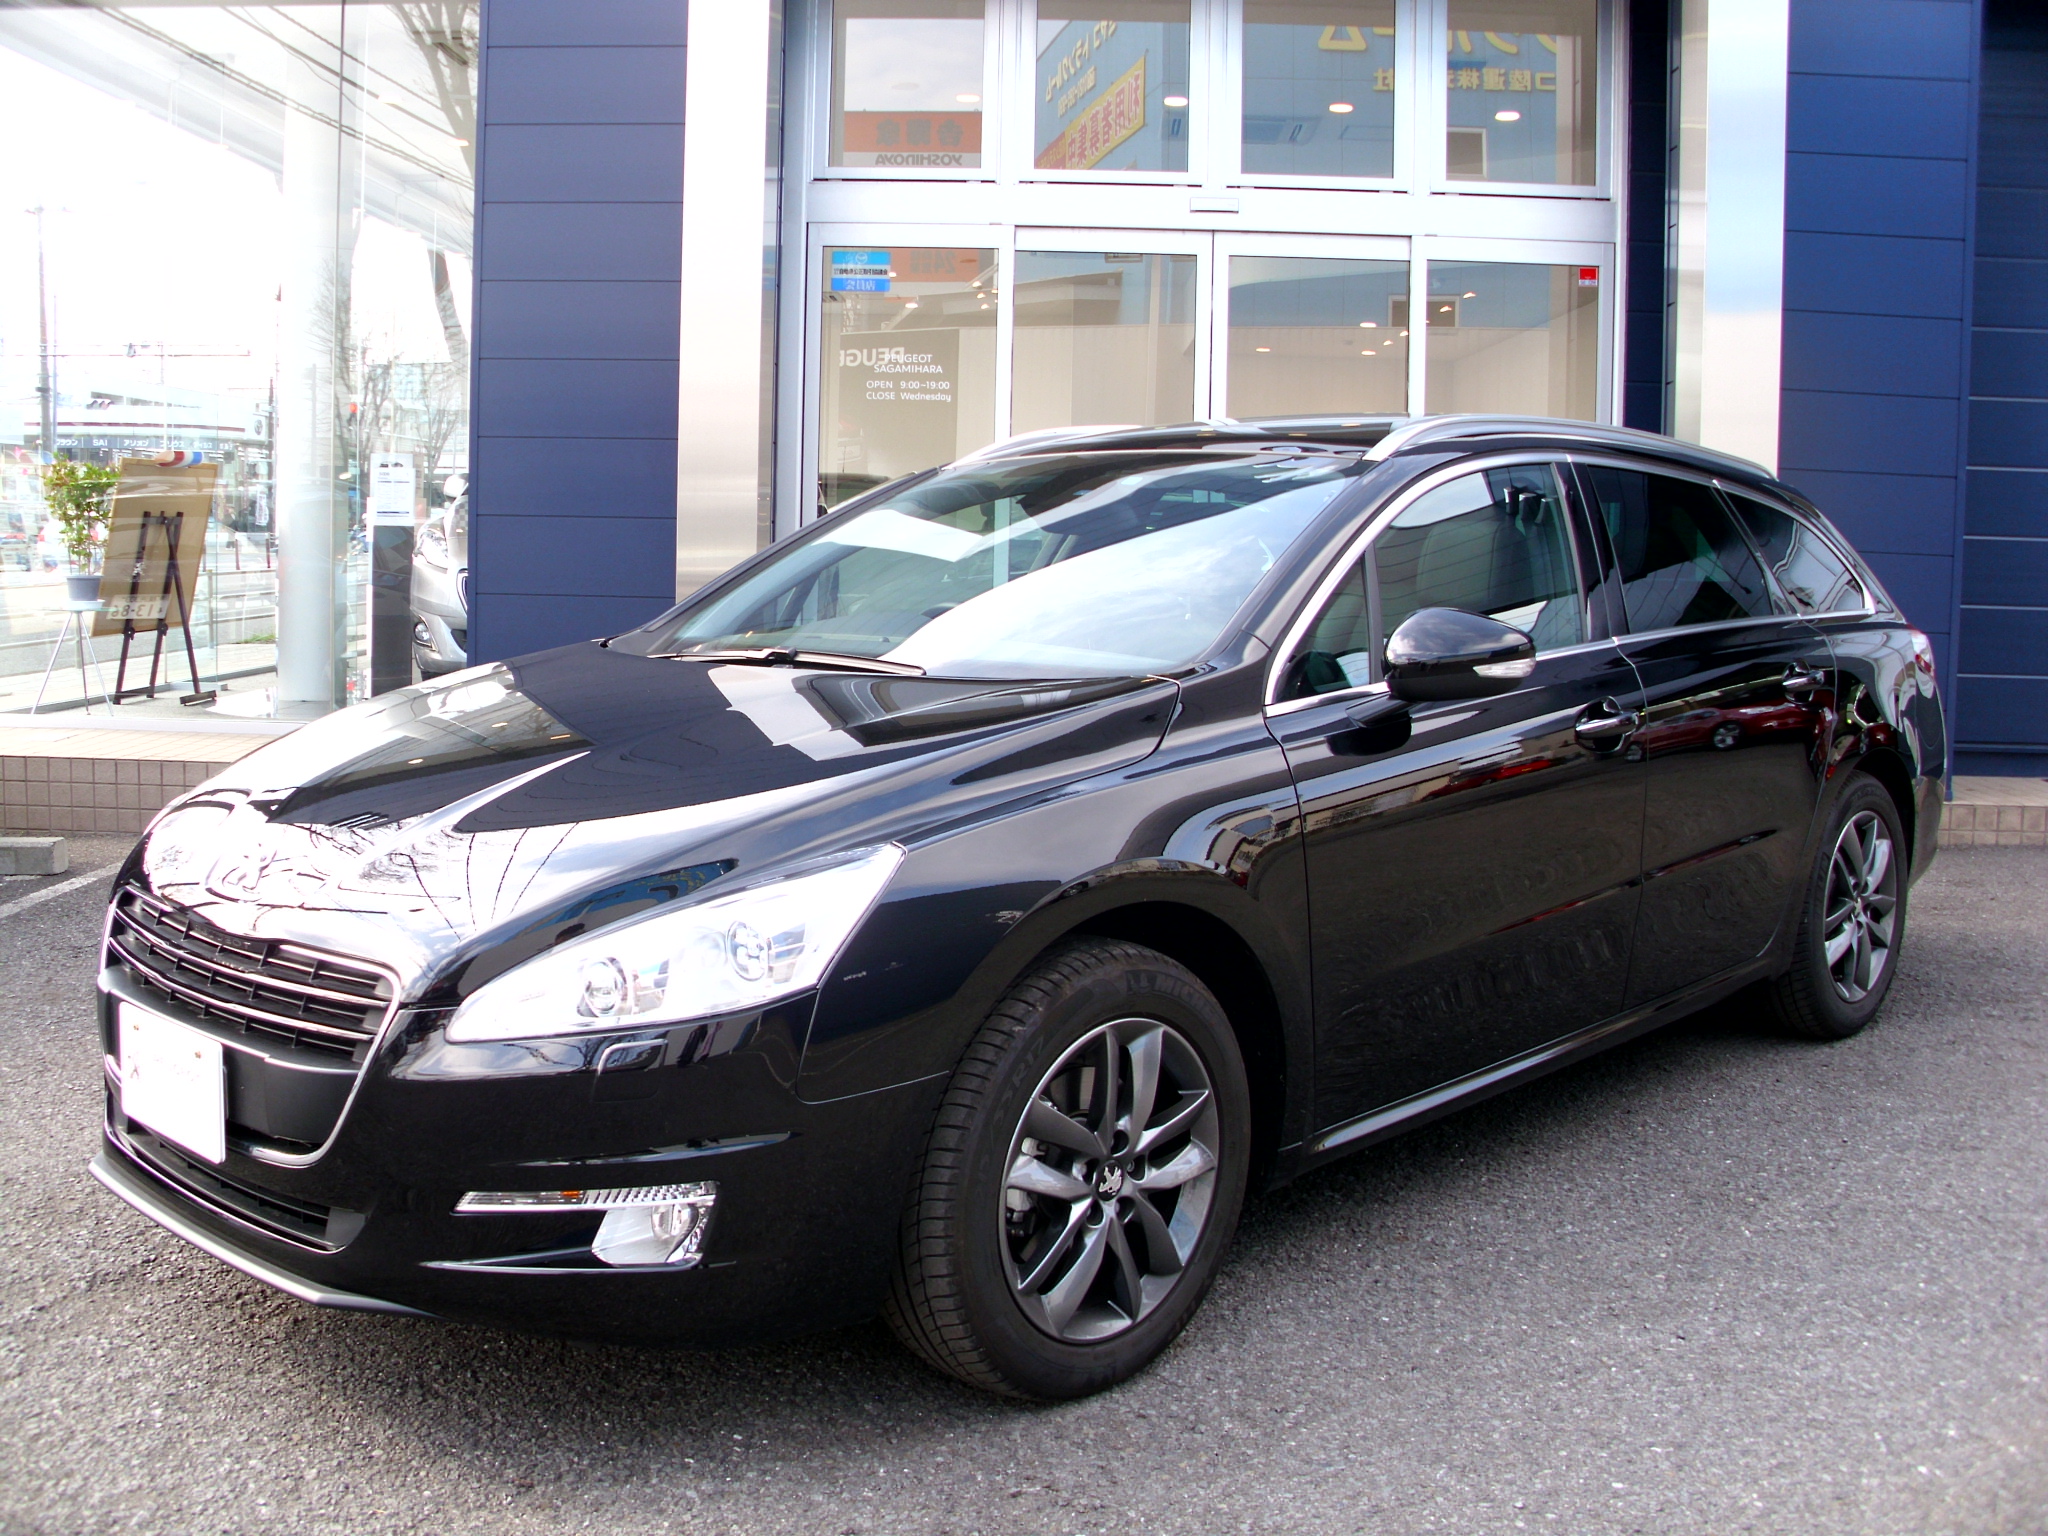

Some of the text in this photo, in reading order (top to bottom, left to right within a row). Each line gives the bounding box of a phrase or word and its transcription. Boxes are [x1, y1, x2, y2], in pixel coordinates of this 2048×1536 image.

[884, 353, 933, 363] PEUGEOT
[874, 364, 942, 374] SAGAMIHARA
[866, 380, 893, 388] OPEN
[866, 391, 951, 402] CLOSE Wednesday
